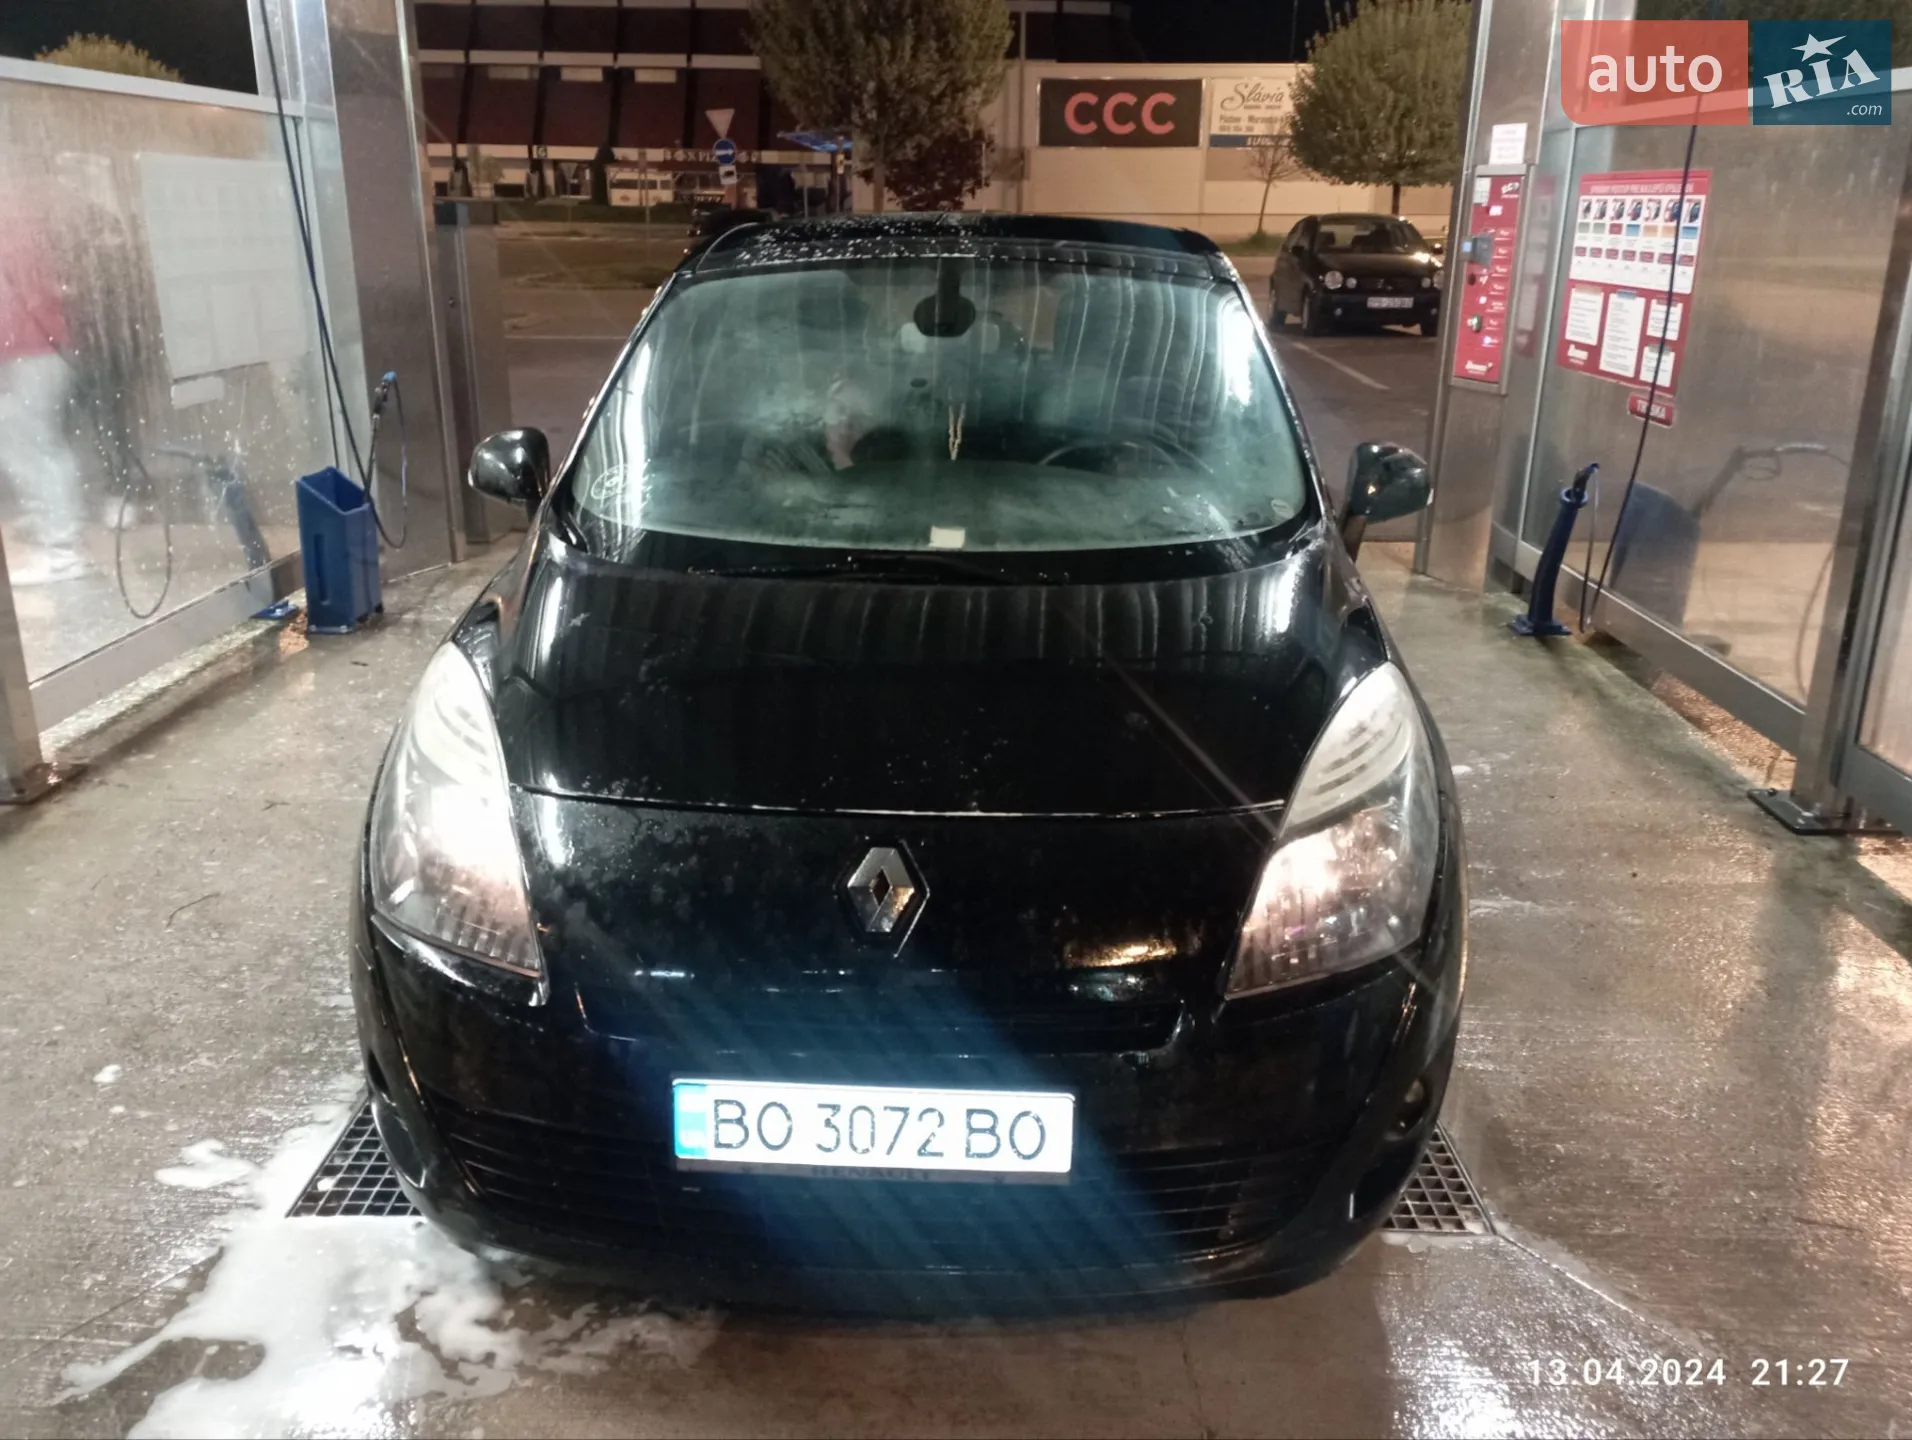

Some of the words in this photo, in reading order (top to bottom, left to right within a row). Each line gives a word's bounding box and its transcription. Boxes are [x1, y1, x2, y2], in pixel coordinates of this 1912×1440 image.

[1063, 92, 1176, 135] CCC
[713, 1099, 793, 1151] BO
[816, 1103, 945, 1158] 3072
[965, 1108, 1046, 1161] BO
